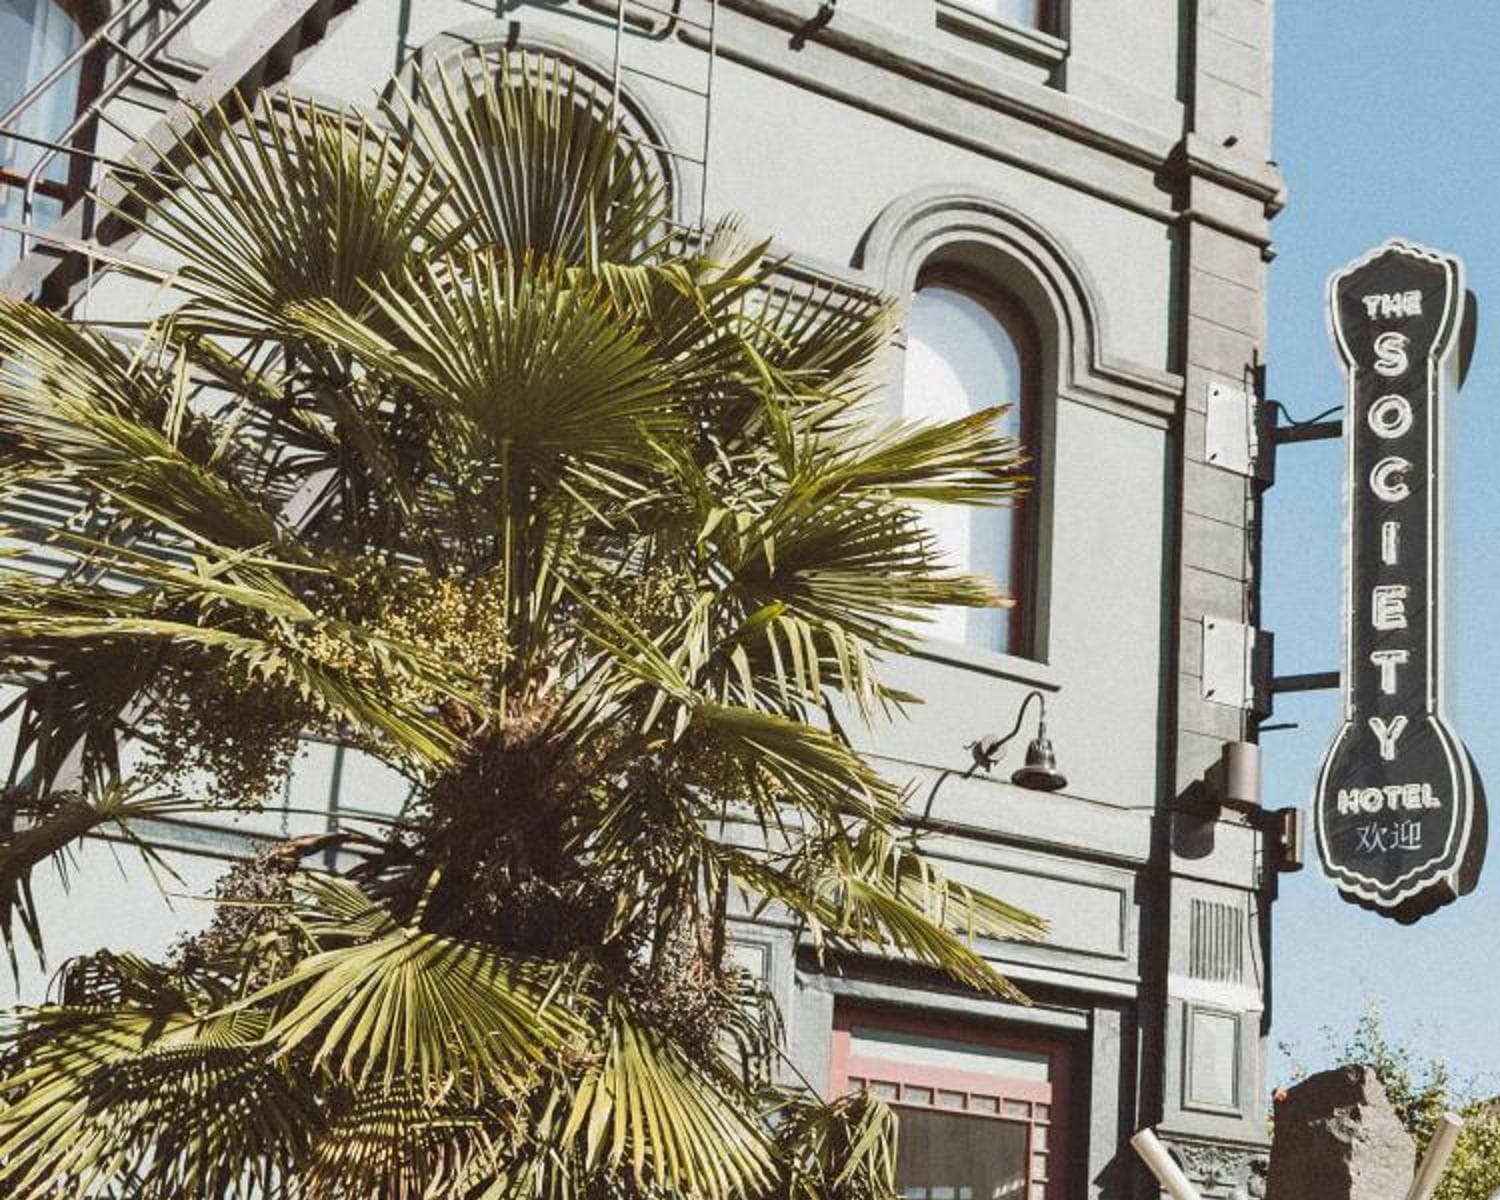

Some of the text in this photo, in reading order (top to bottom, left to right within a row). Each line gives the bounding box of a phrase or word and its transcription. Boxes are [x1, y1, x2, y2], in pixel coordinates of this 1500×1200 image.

[1362, 290, 1423, 320] THE
[1367, 331, 1413, 760] SOCIETY
[1337, 784, 1441, 815] HOTEL
[1356, 820, 1423, 852] 欢迎
